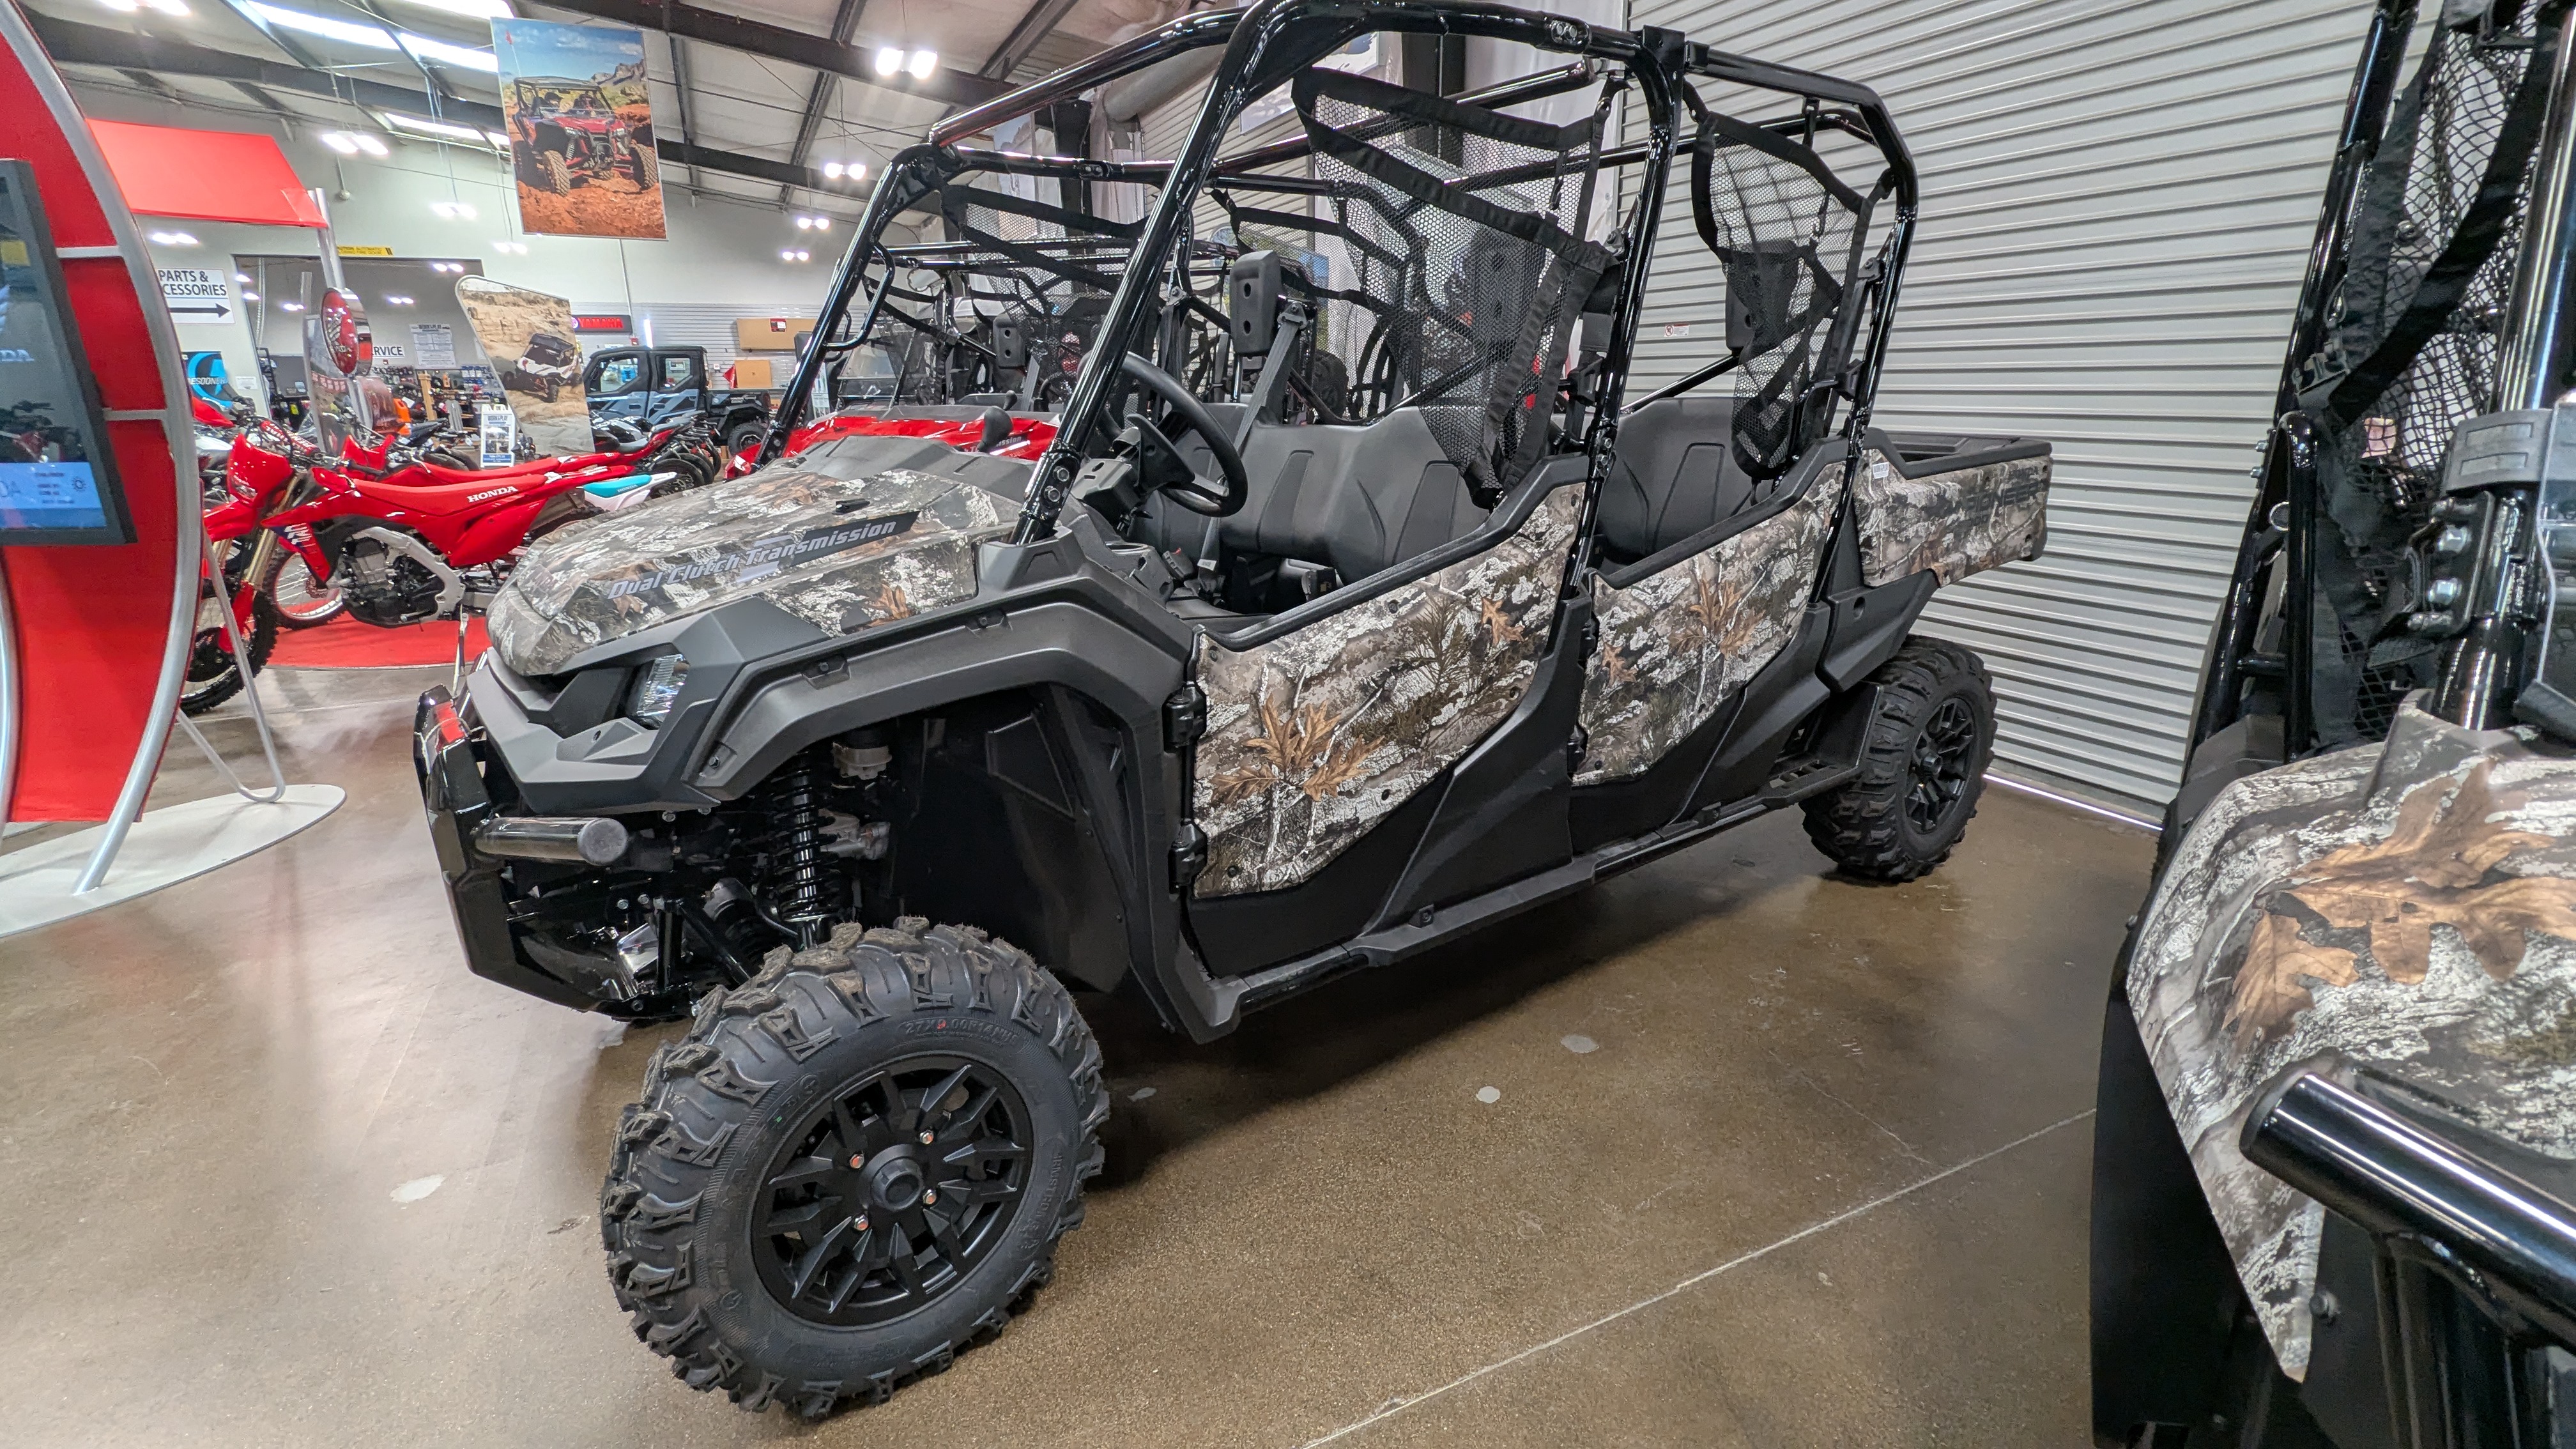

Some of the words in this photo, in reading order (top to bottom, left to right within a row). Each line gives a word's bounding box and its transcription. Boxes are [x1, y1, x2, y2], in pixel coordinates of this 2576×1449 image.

[158, 270, 197, 282] PARTS
[199, 270, 209, 282] &
[162, 284, 227, 296] CESSORIES
[578, 316, 624, 329] YAMAHA
[0, 349, 34, 363] DA
[373, 346, 404, 356] RVICE
[467, 486, 519, 503] HONDA
[608, 574, 662, 600] Dual
[666, 553, 740, 585] Clutch
[746, 521, 896, 563] Transmission
